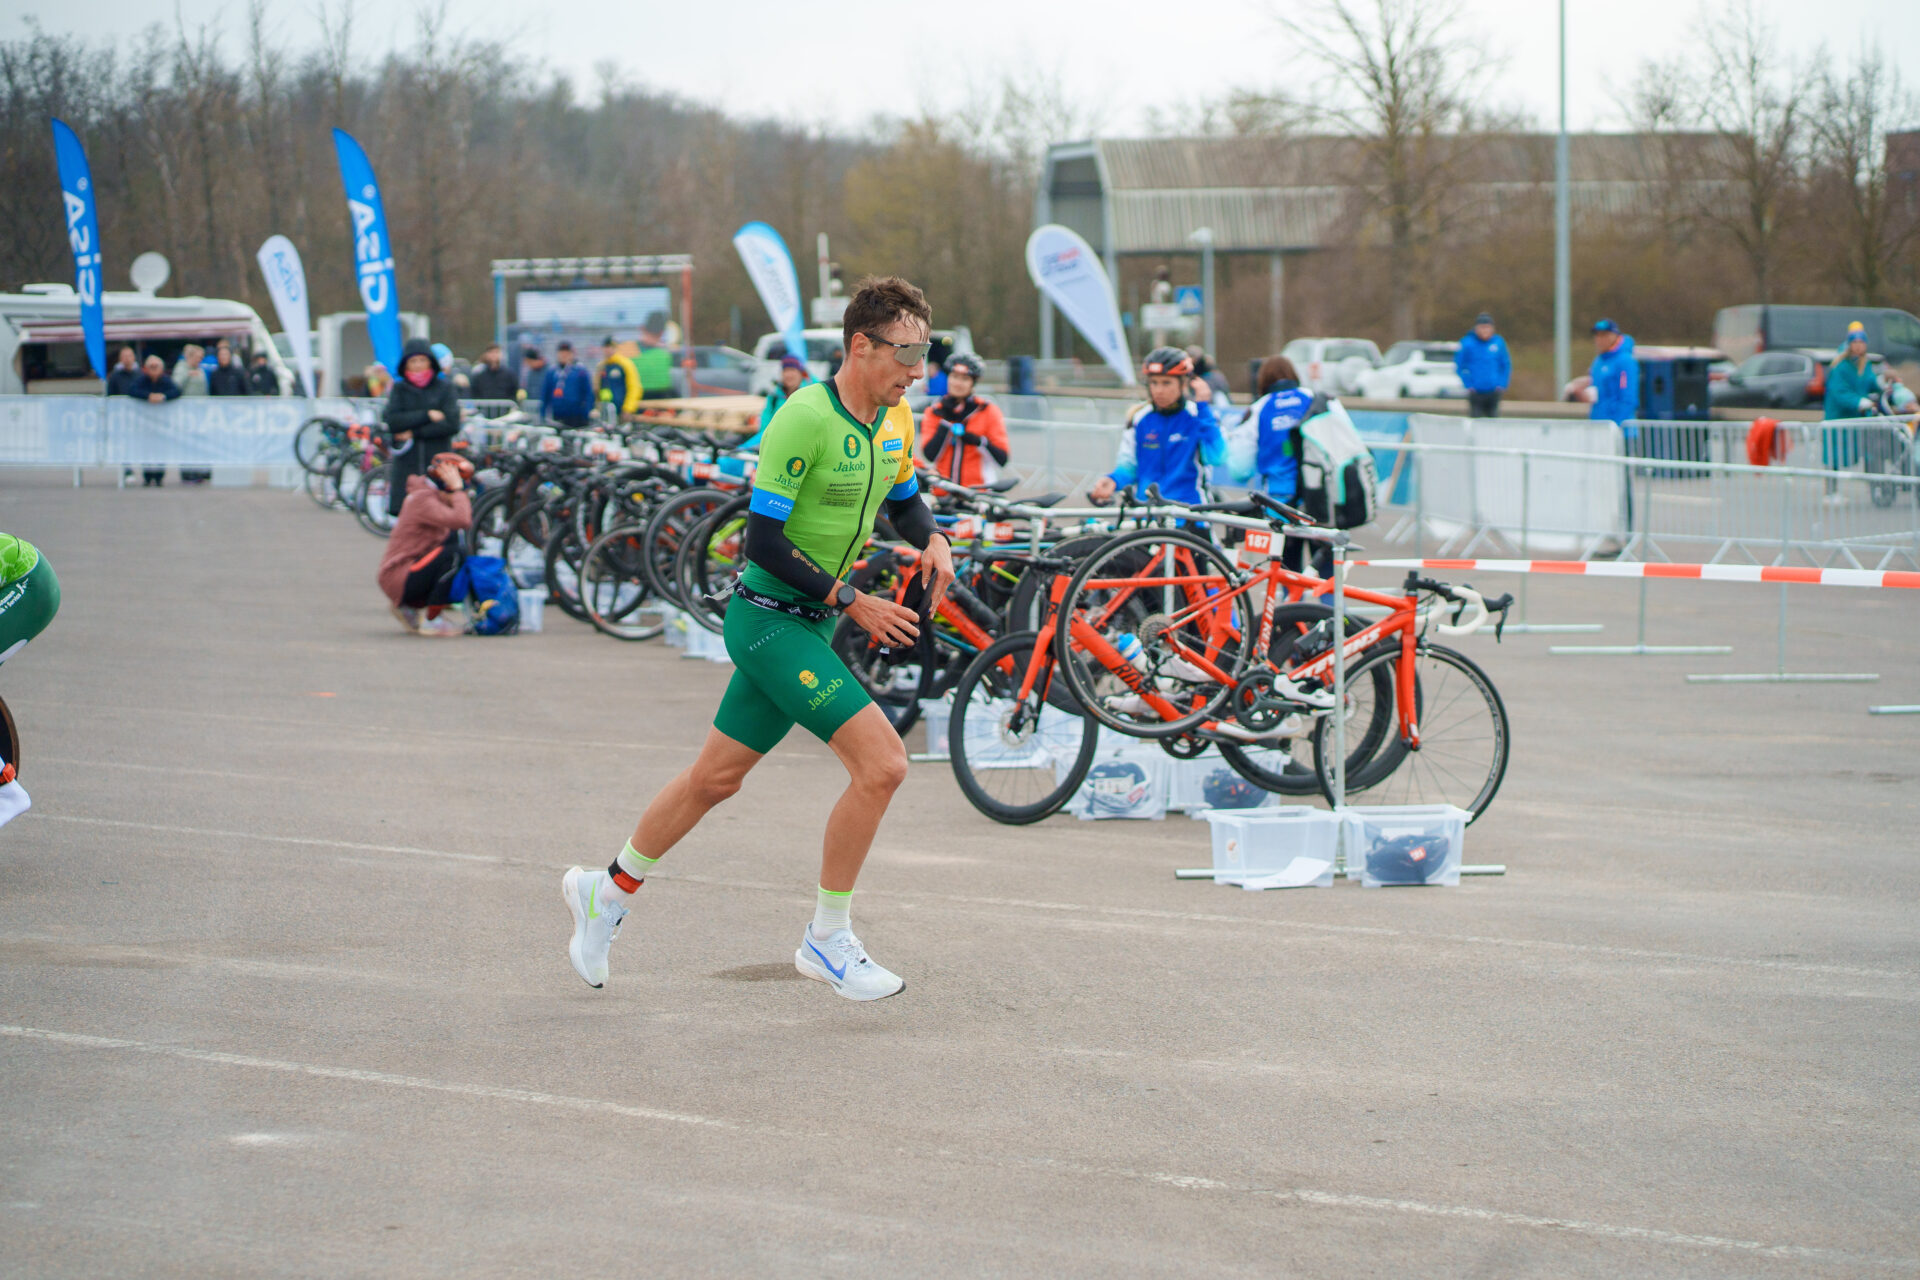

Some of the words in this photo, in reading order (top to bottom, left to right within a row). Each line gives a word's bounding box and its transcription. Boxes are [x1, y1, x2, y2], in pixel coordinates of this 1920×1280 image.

[833, 461, 866, 472] Jakob
[1247, 533, 1270, 549] 187
[754, 595, 779, 608] sailfish
[808, 678, 843, 711] Jakob
